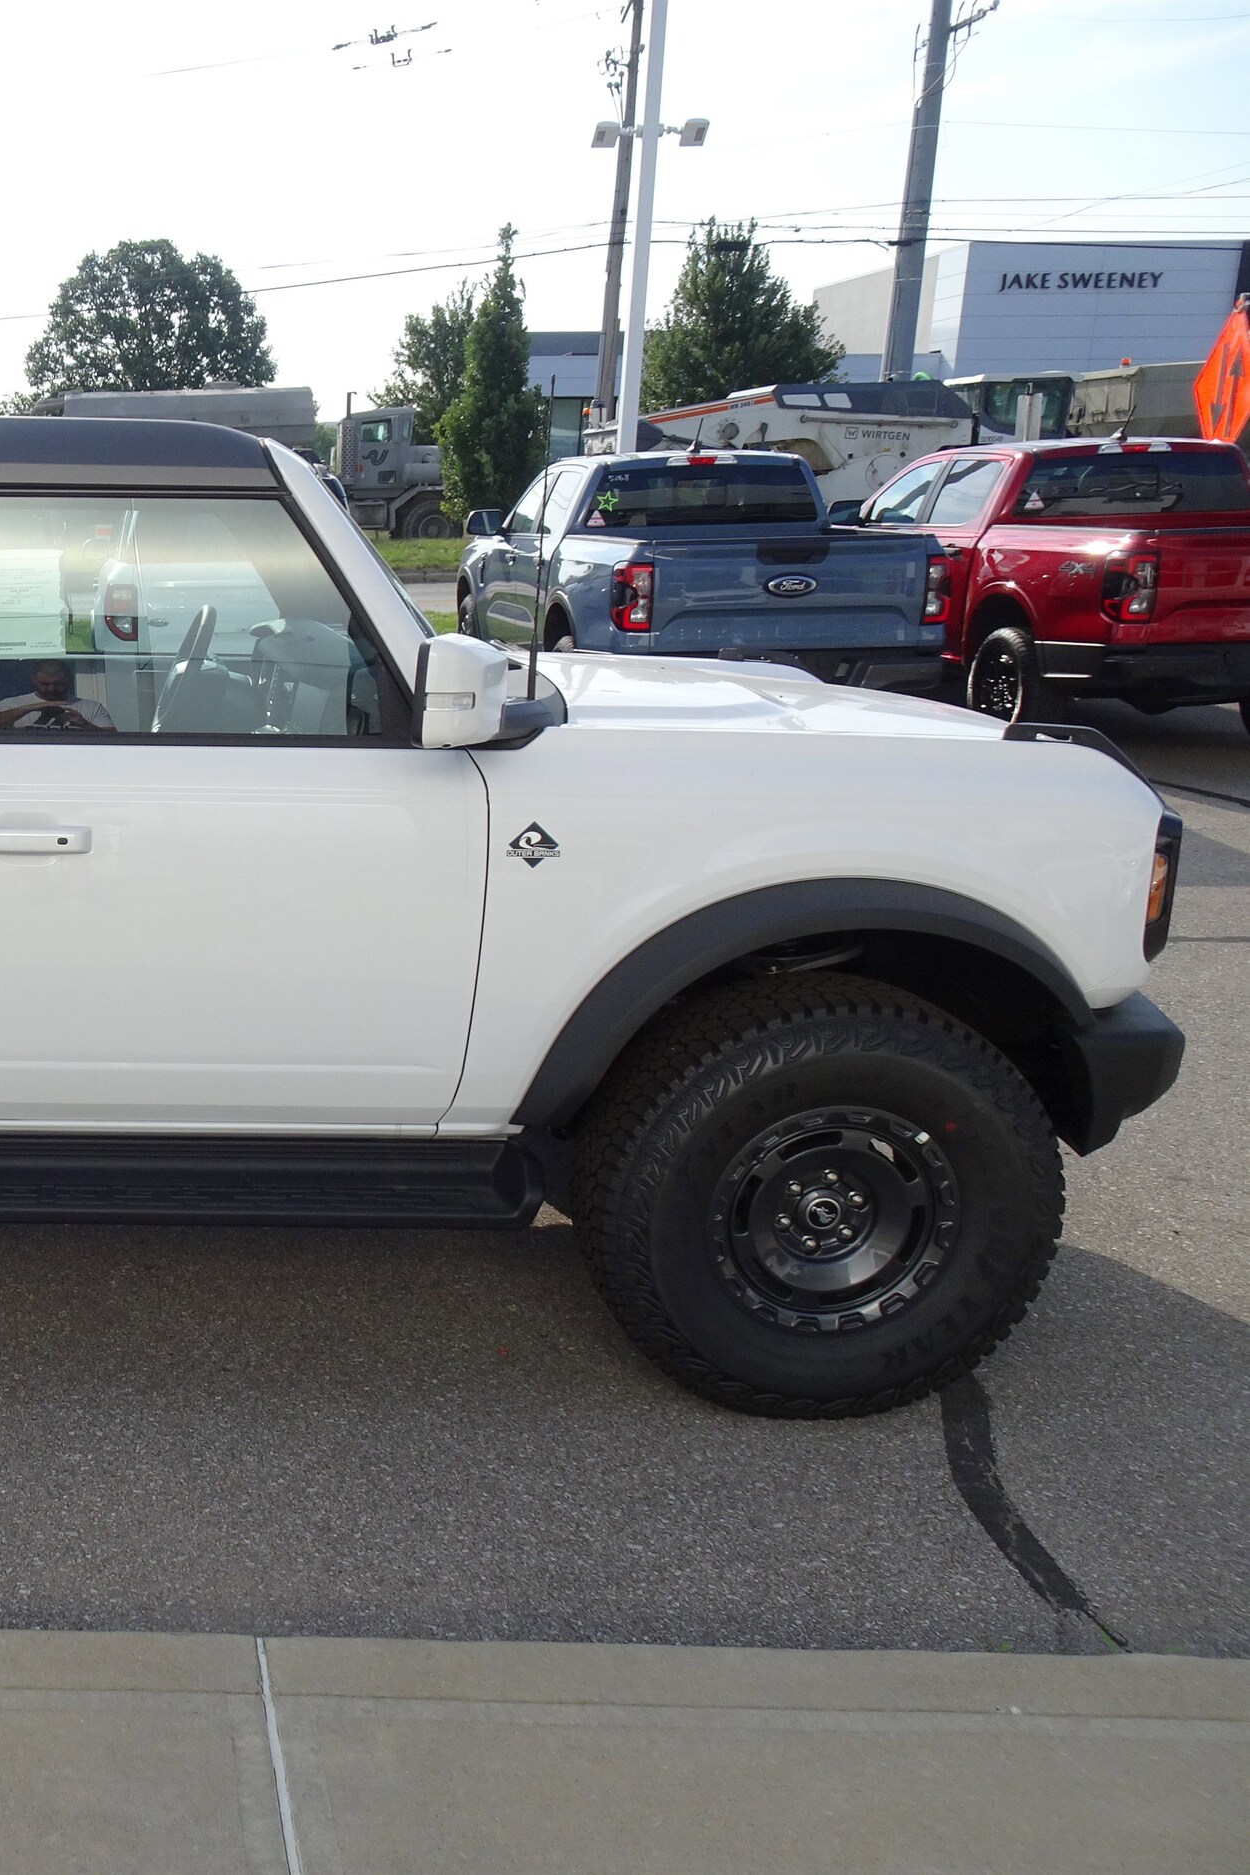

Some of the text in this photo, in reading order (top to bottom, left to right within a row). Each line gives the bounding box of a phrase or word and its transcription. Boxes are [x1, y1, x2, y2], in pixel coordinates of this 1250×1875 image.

[998, 272, 1164, 292] JAKE SWEENEY
[862, 429, 911, 441] WIRTGEN
